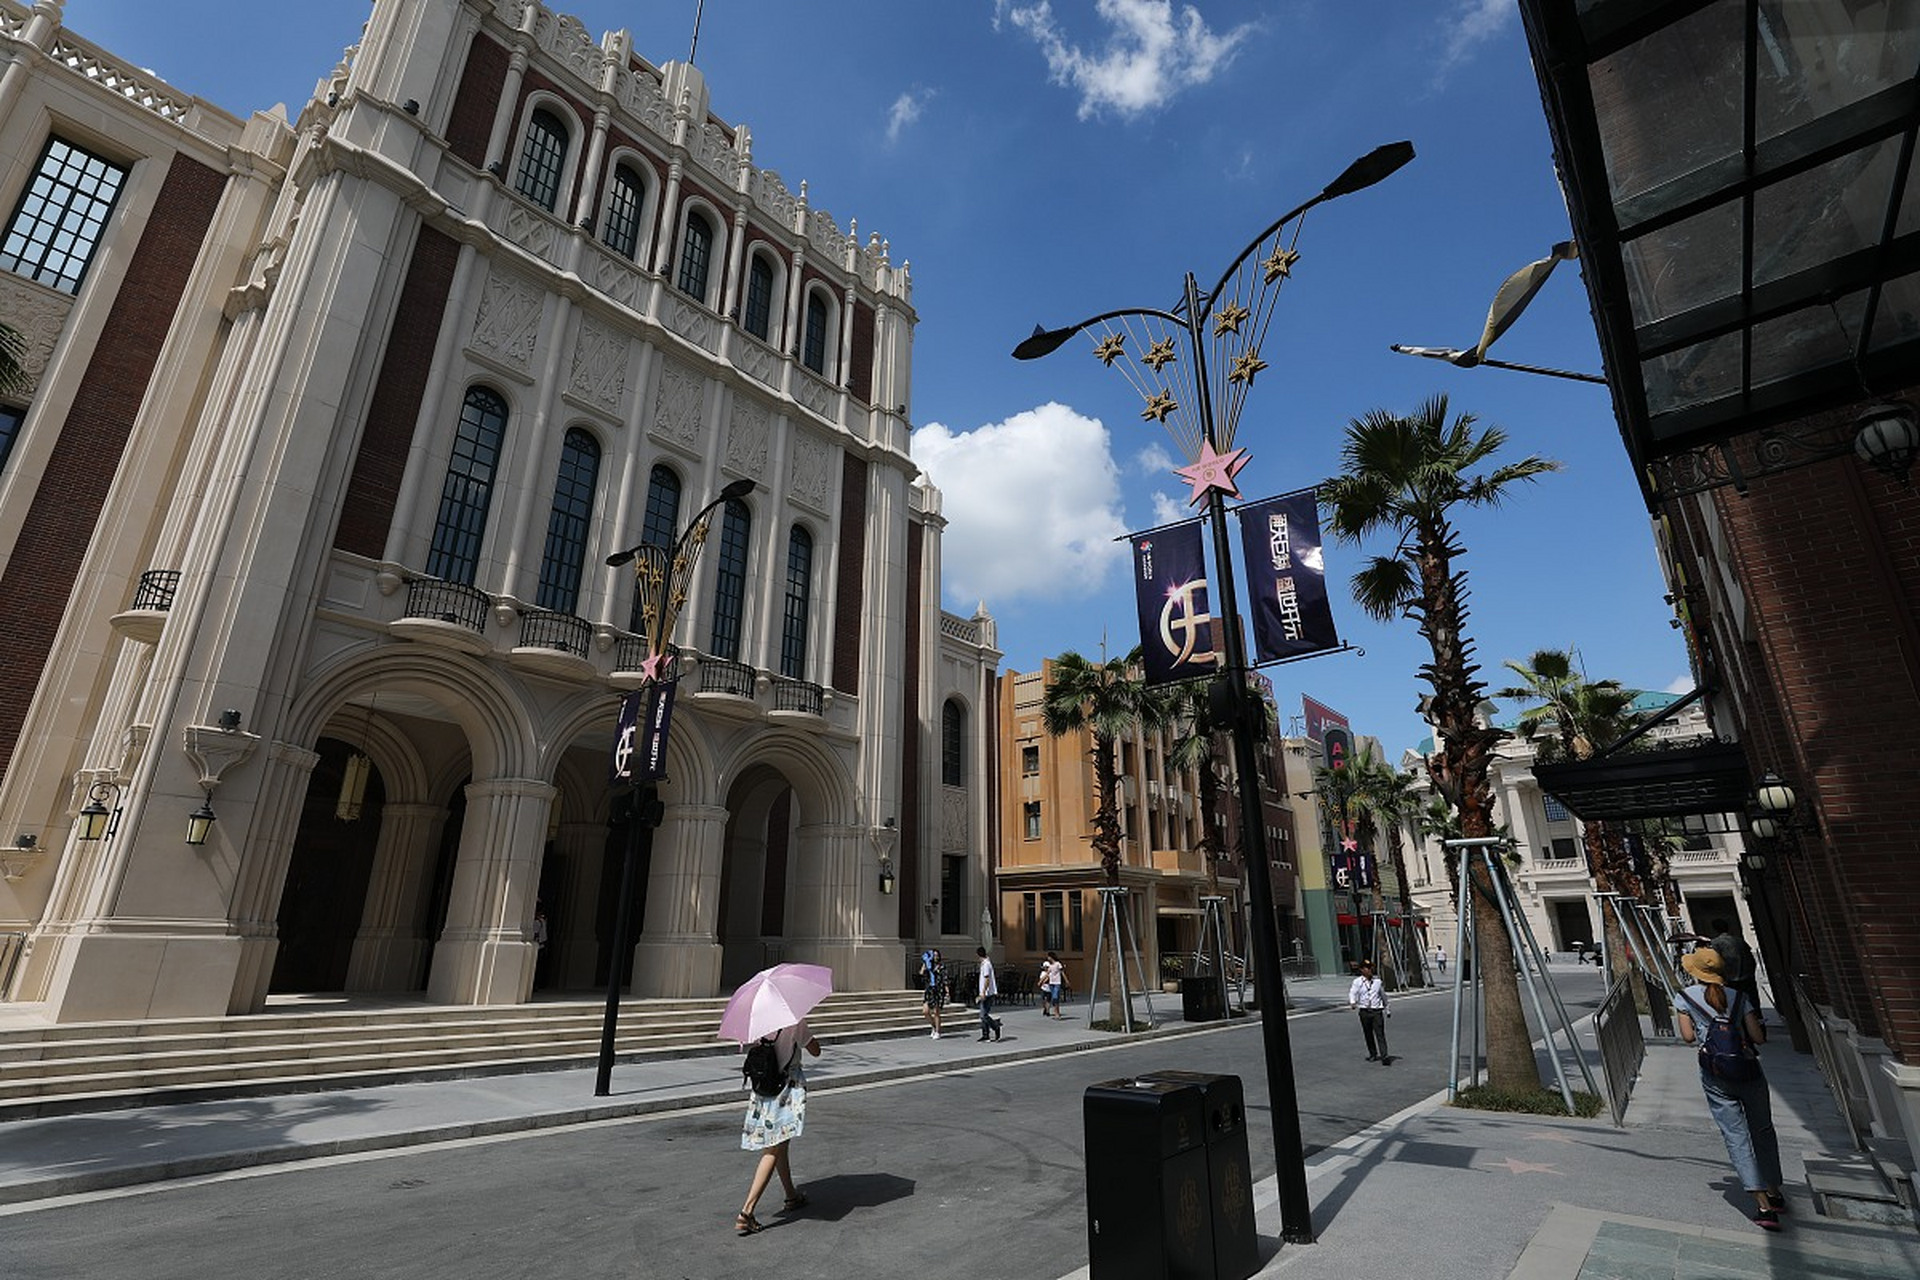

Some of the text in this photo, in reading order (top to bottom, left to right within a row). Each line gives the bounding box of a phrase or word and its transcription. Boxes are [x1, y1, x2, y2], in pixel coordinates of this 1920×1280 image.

[1269, 514, 1304, 641] 通天巨制 盛世开元
